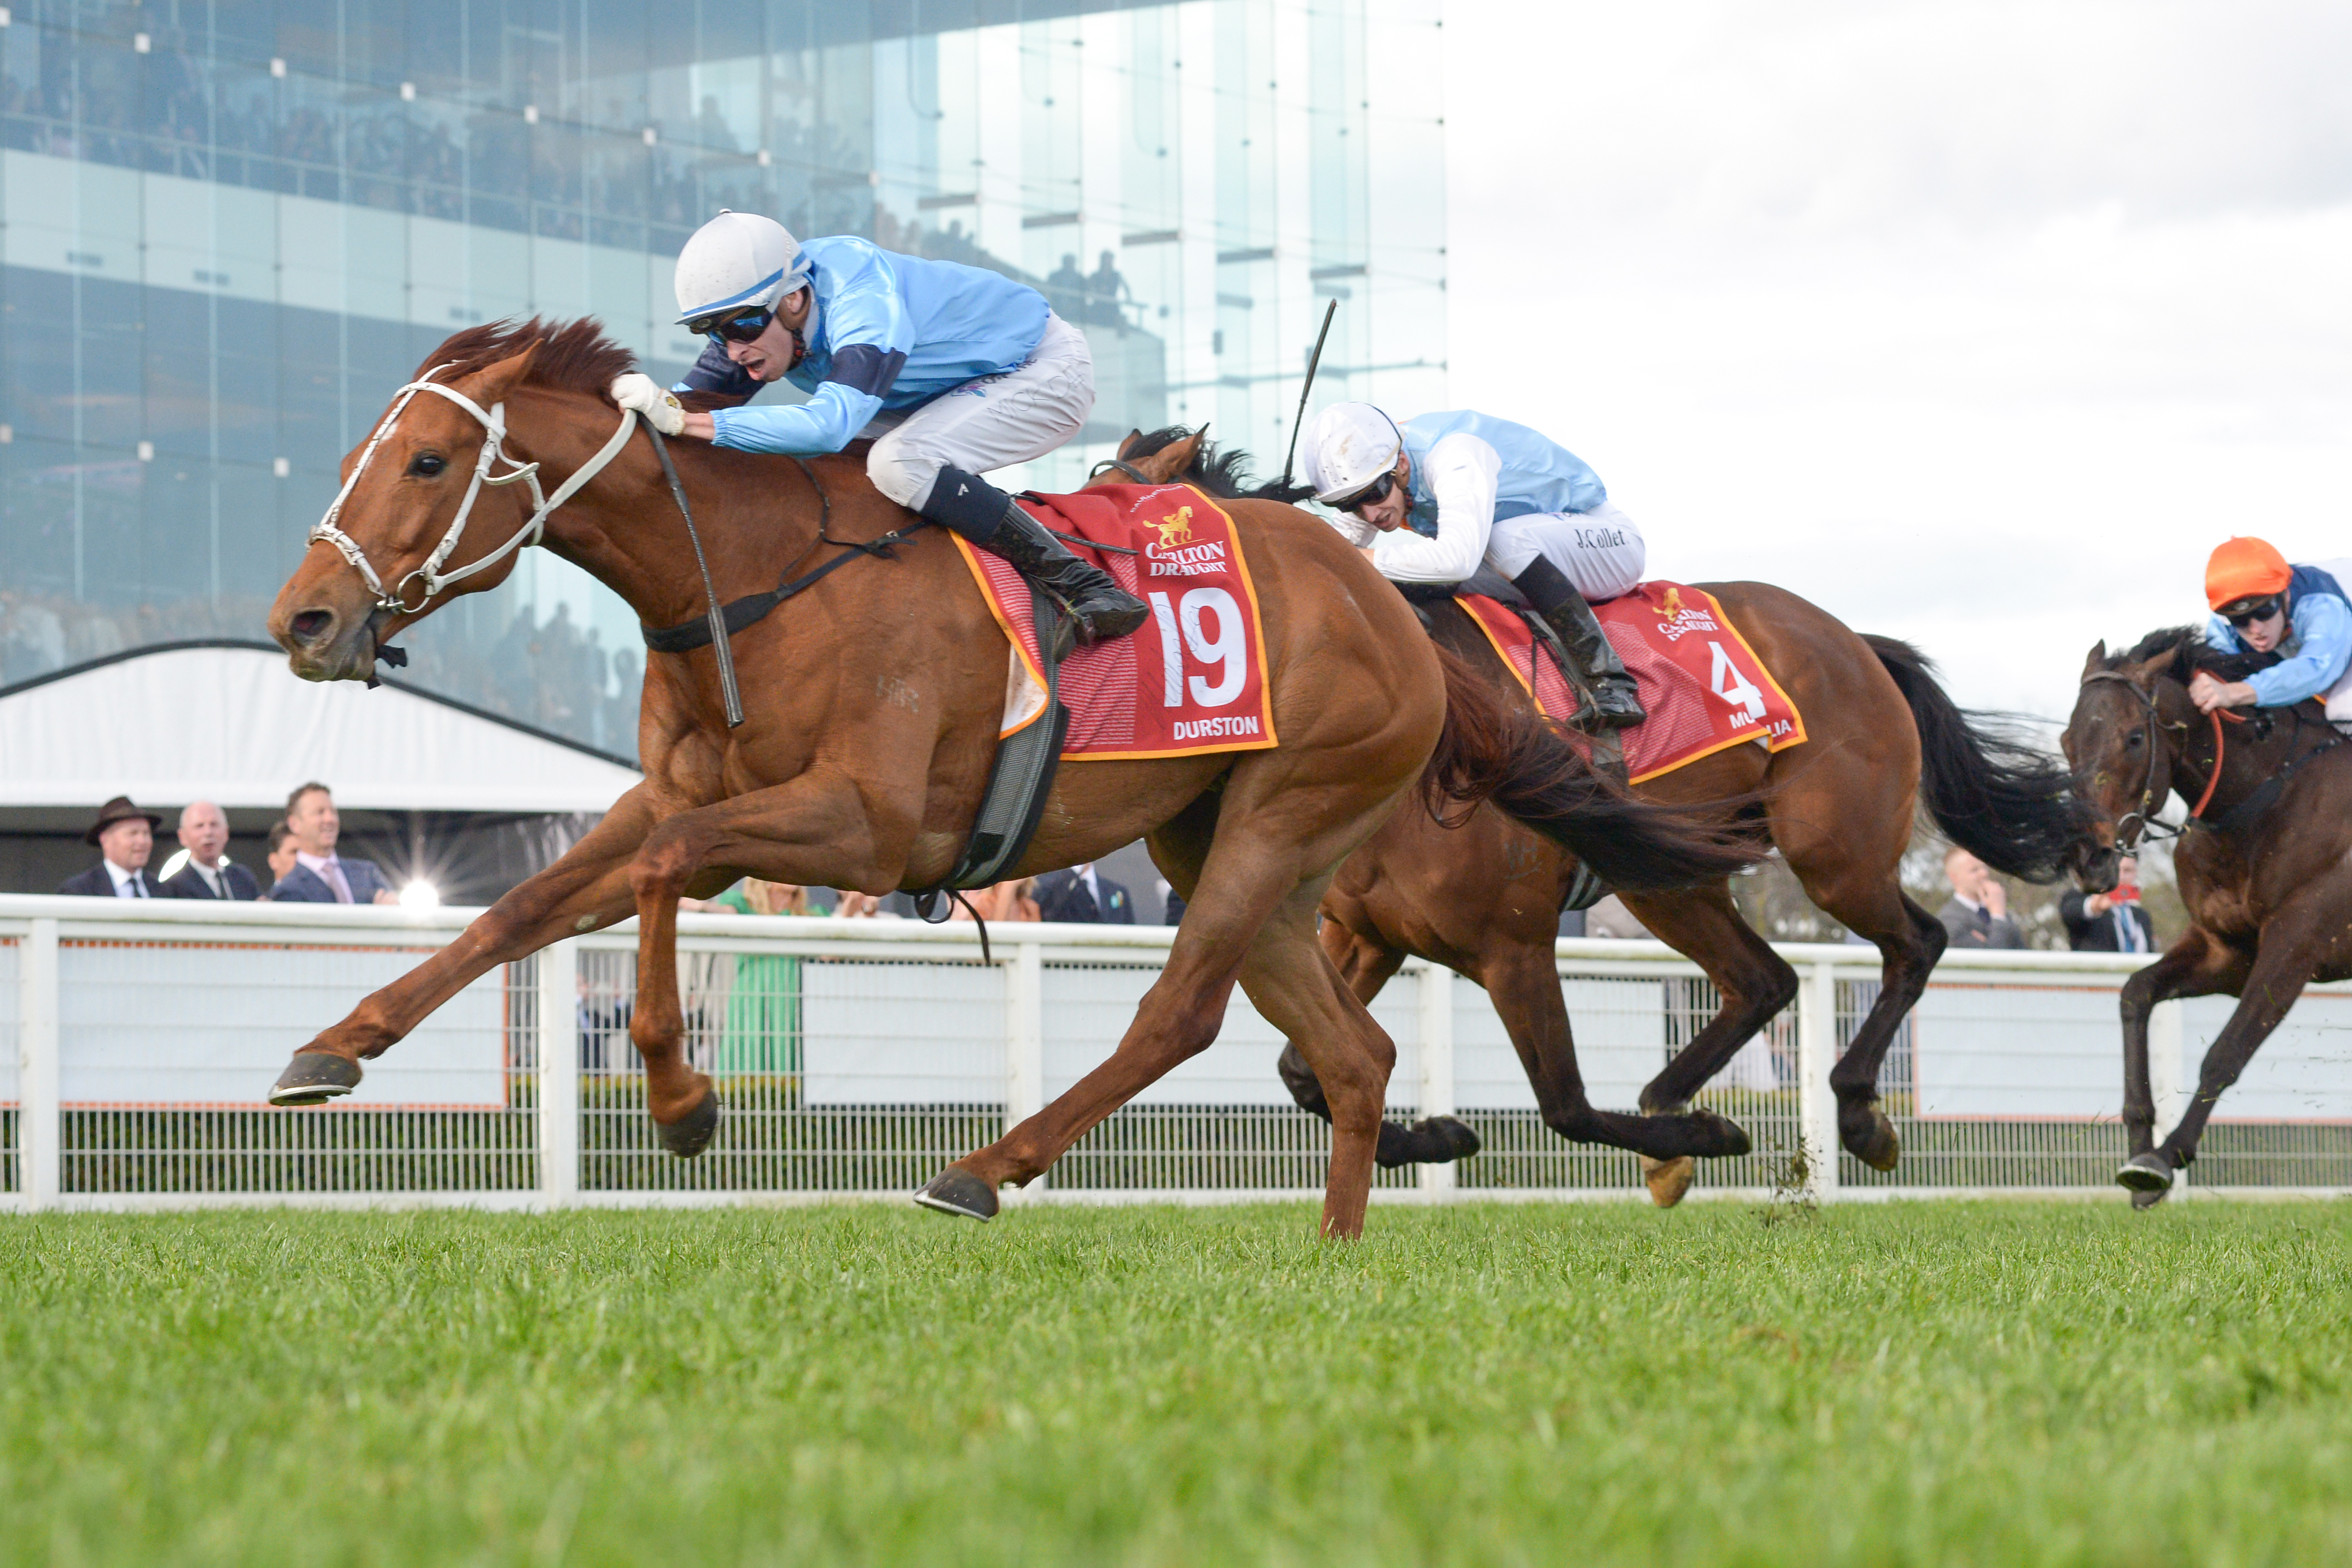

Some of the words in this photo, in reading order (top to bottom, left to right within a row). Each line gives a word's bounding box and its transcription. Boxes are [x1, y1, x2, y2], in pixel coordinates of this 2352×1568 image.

[1149, 562, 1228, 577] DRAUGHT
[1147, 587, 1247, 708] 19
[1707, 641, 1767, 720] 4
[1173, 716, 1259, 740] DURSTON
